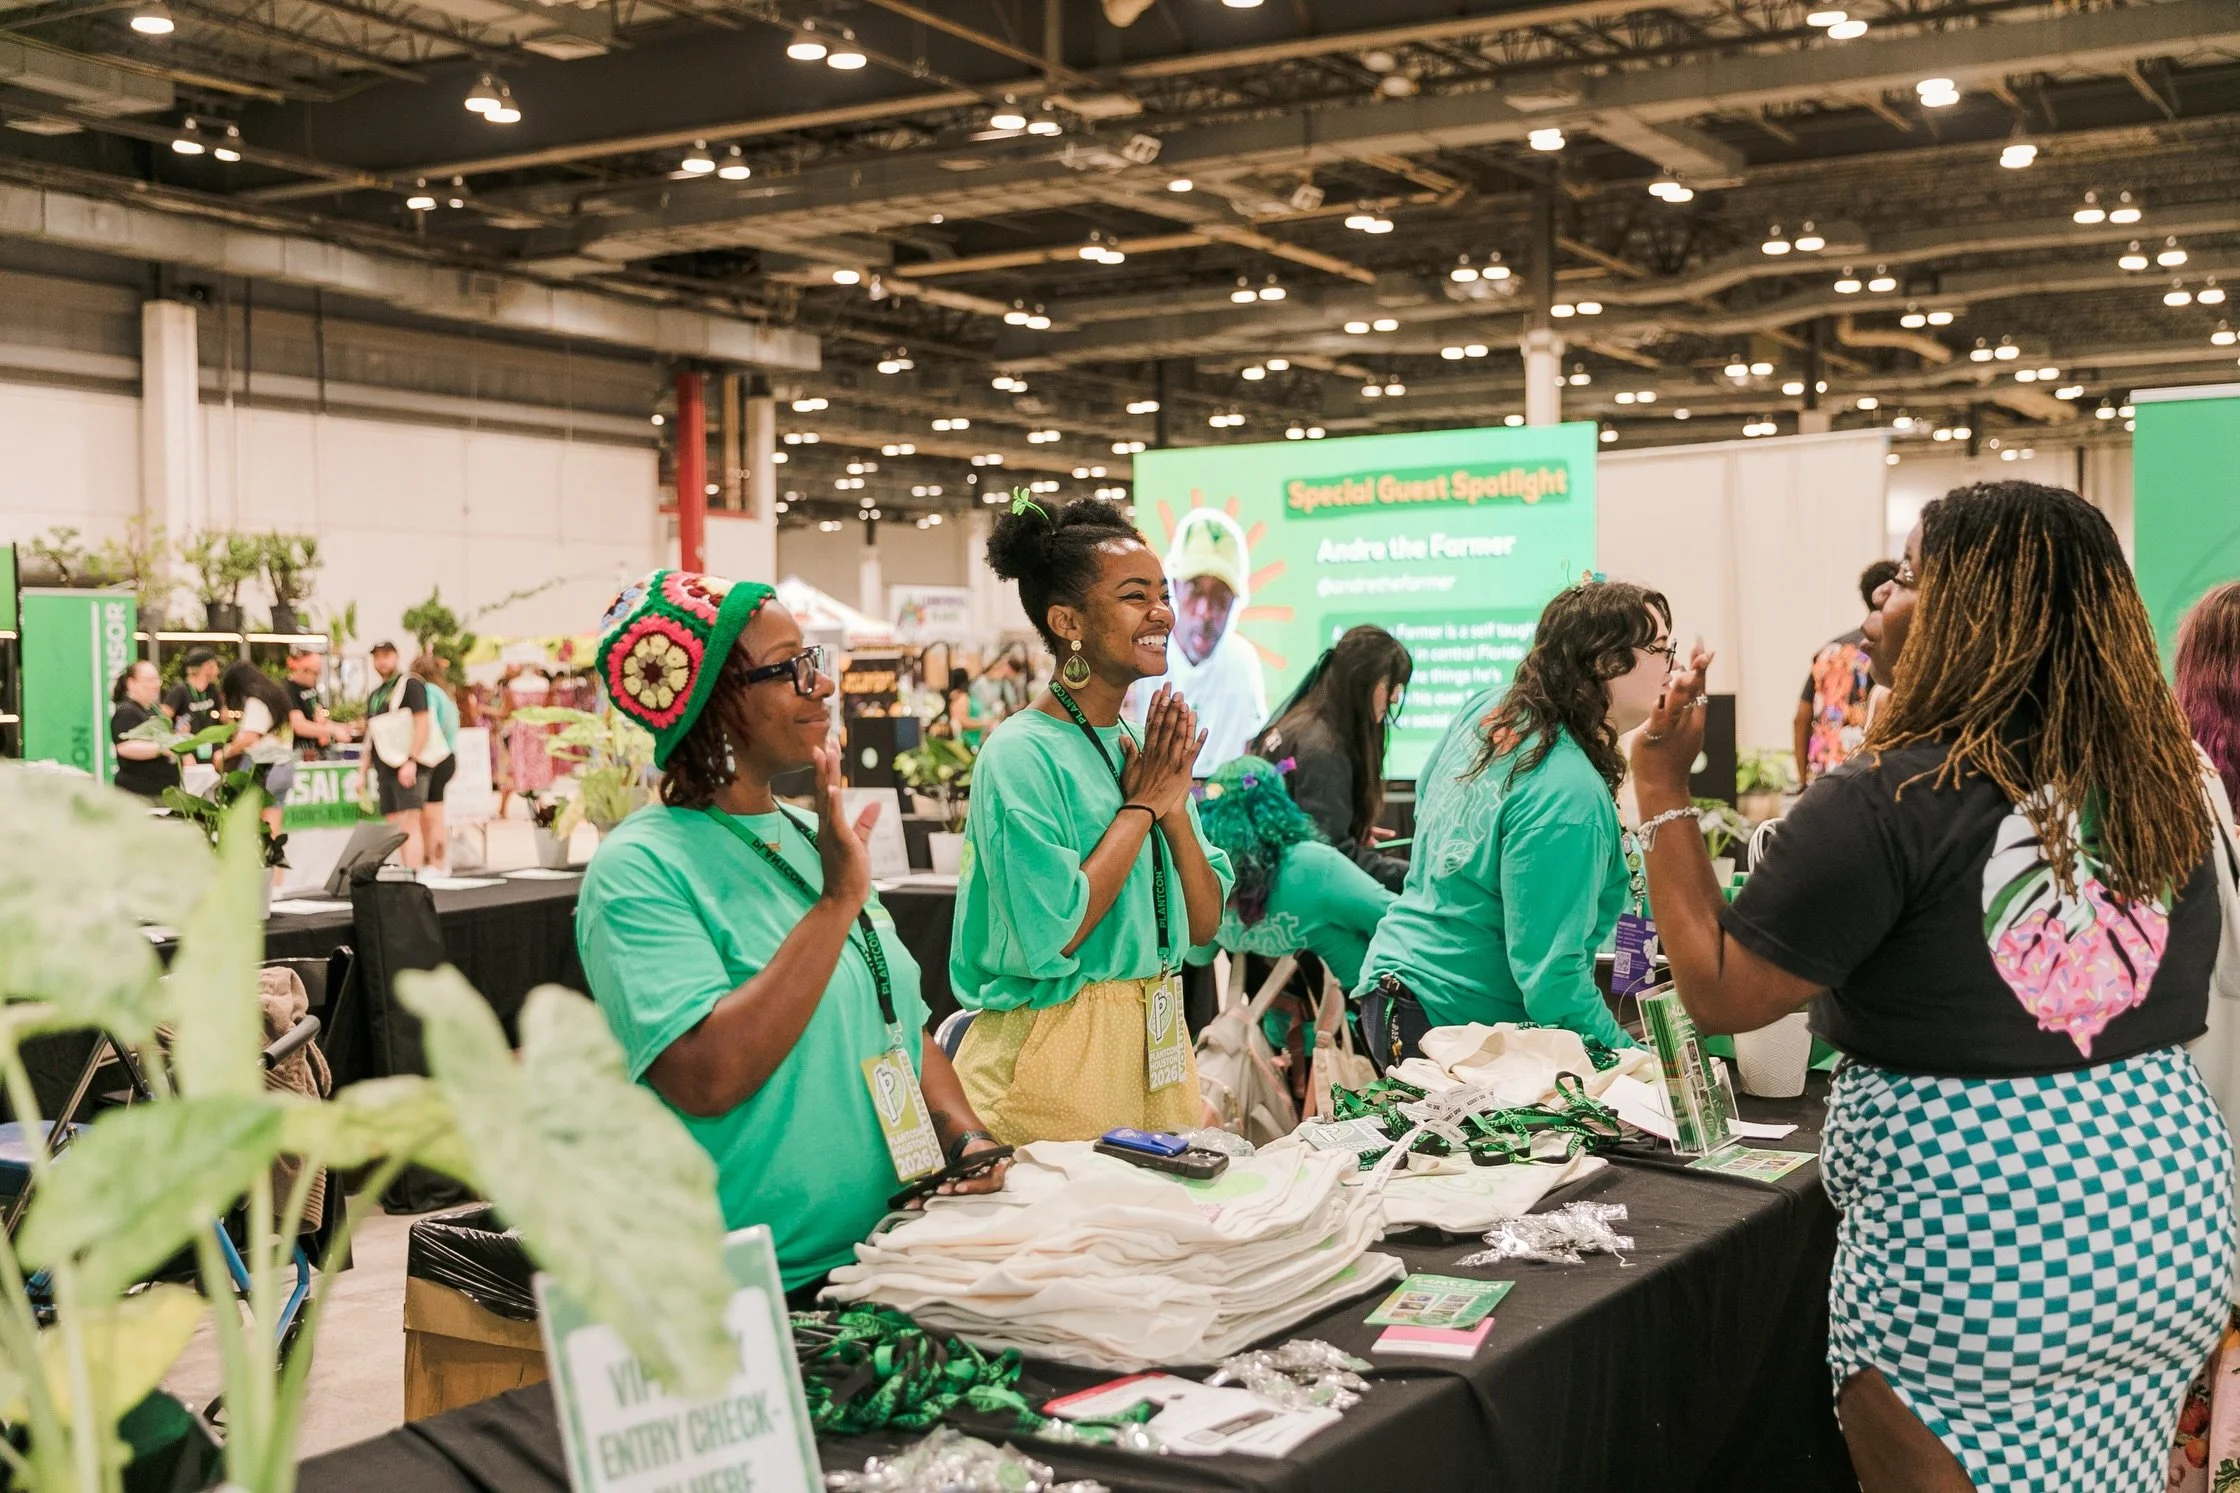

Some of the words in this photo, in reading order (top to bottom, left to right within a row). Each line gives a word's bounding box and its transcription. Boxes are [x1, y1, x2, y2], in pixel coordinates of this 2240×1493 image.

[1288, 478, 1374, 513] Special
[1377, 474, 1448, 504] Guest
[1451, 466, 1569, 505] Spotlight
[1316, 537, 1386, 563] Andre
[1388, 534, 1427, 561] the
[1429, 532, 1517, 559] Farmer
[1396, 623, 1443, 640] Farmer
[1445, 622, 1458, 640] is
[1459, 625, 1469, 640] a
[1470, 621, 1496, 640] self
[1497, 621, 1536, 641] taugh
[1415, 645, 1429, 662] in
[1412, 668, 1429, 684] he
[1430, 667, 1472, 687] things
[1473, 664, 1504, 684] he's
[1151, 1066, 1179, 1089] 2026
[899, 1149, 933, 1178] 2026
[598, 1413, 682, 1481] ENTRY
